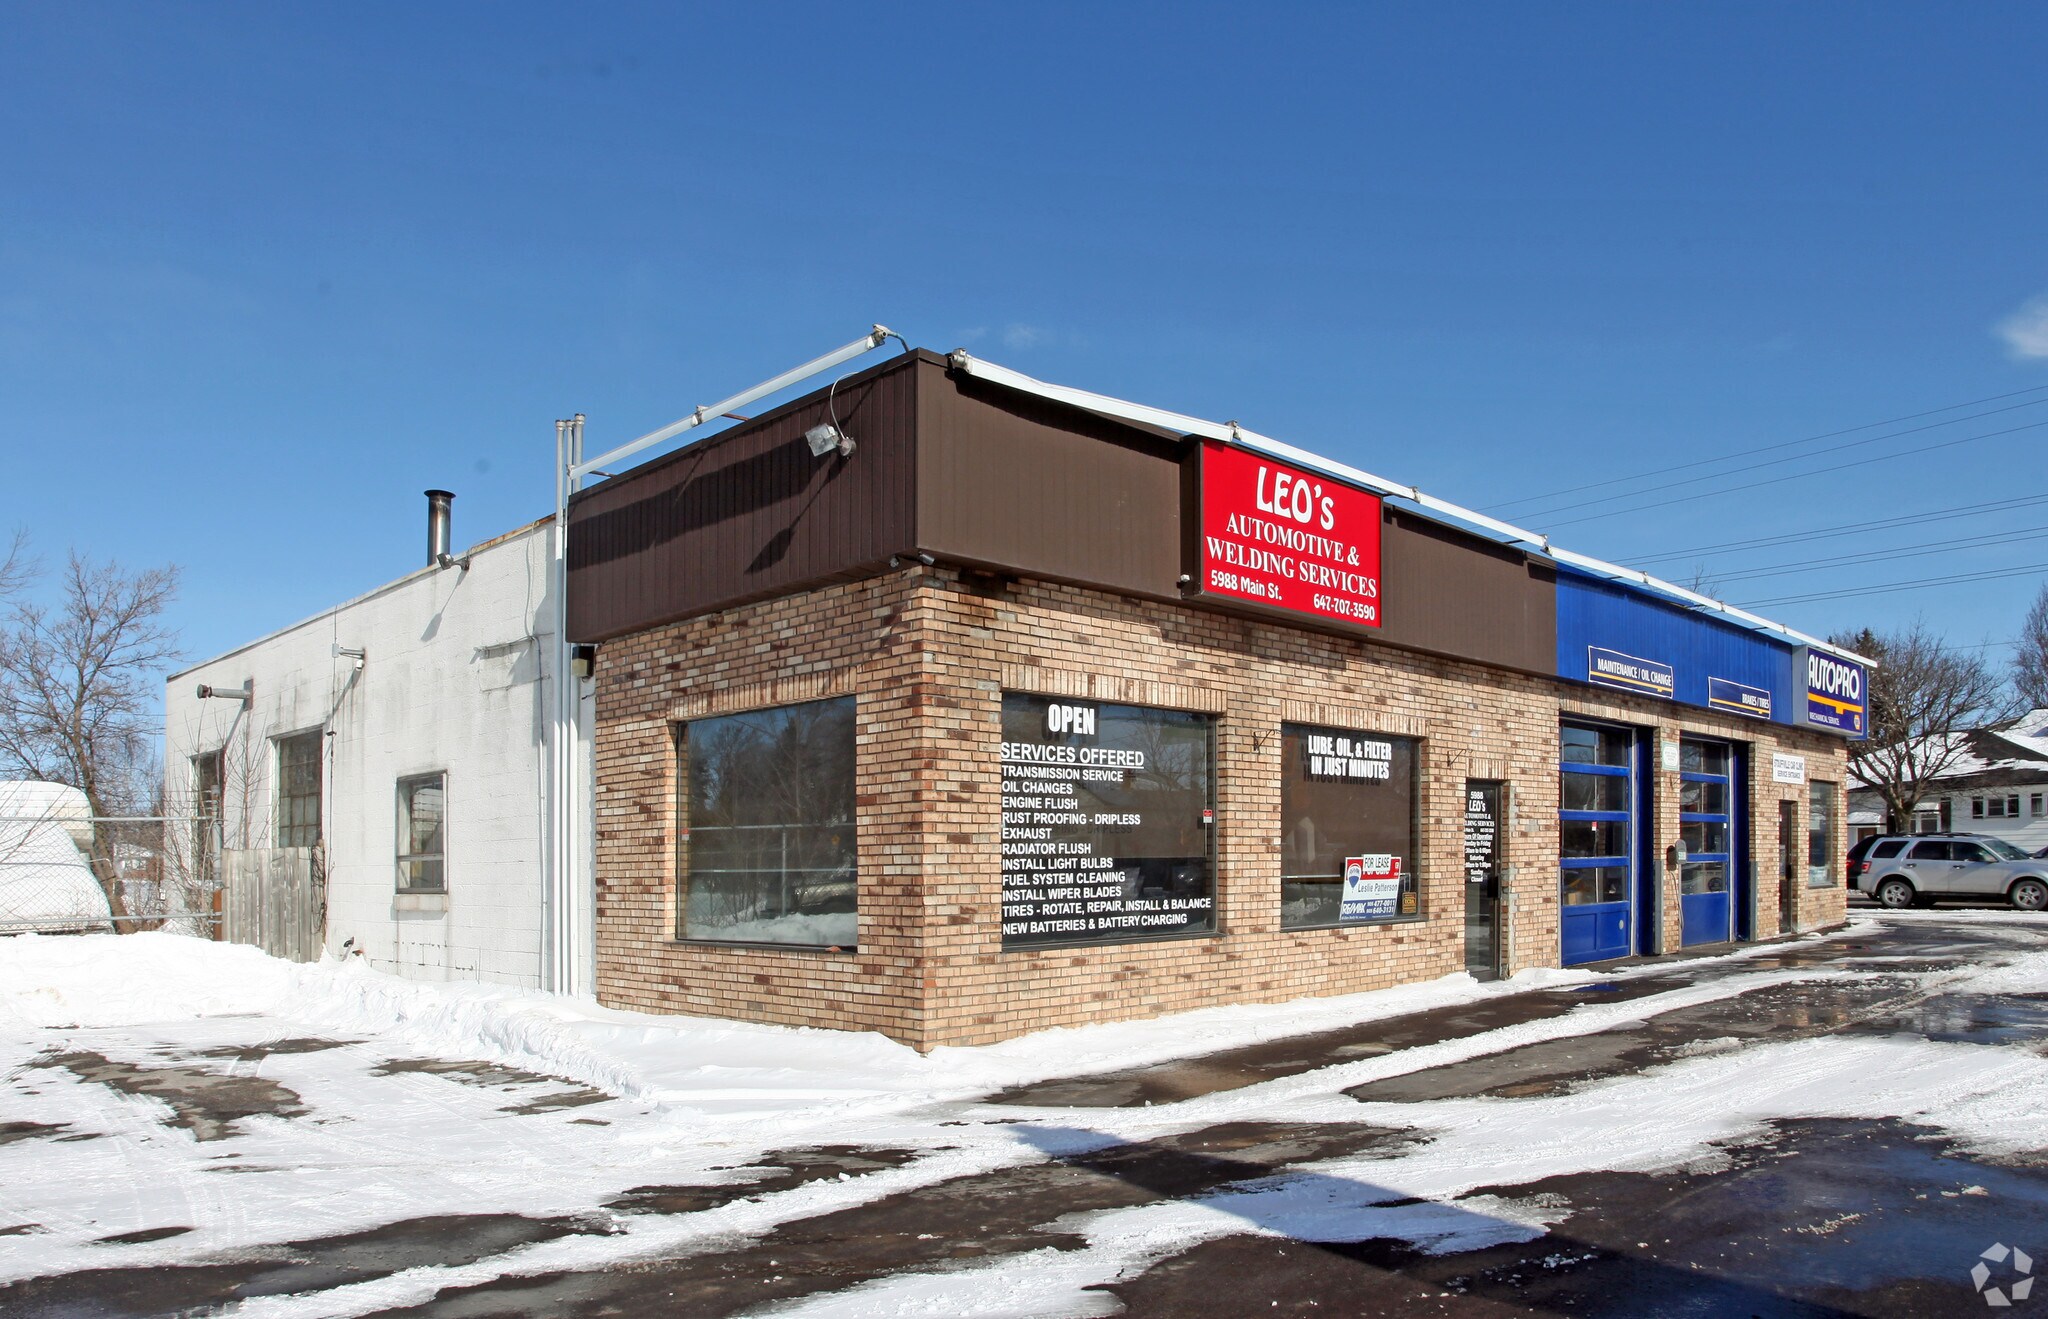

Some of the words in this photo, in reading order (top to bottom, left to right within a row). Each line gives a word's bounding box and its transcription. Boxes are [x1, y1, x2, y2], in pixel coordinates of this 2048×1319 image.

[1256, 466, 1334, 530] LEO's
[1226, 512, 1344, 562] AUTOMOTIVE
[1347, 546, 1360, 566] &
[1206, 535, 1295, 578] WELDING
[1300, 561, 1377, 598] SERVICES
[1211, 569, 1238, 590] 5988
[1240, 576, 1265, 597] Main
[1267, 583, 1283, 600] St.
[1313, 593, 1375, 621] 647-707-3590
[1597, 658, 1638, 679] MAINTENANCE
[1641, 669, 1650, 681] OIL
[1650, 671, 1672, 687] CHANGE
[1808, 654, 1860, 700] AUTOPRO
[1048, 704, 1095, 735] OPEN
[1000, 742, 1076, 763] SERVICES
[1079, 747, 1145, 766] OFFERED
[1308, 735, 1335, 757] LUBE,
[1336, 738, 1354, 758] OIL,
[1355, 743, 1363, 757] &
[1364, 740, 1392, 761] FILTER
[1002, 765, 1080, 780] TRANSMISSION
[1082, 769, 1124, 782] SERVICE
[1311, 756, 1322, 775] IN
[1324, 757, 1349, 777] JUST
[1349, 759, 1390, 779] MINUTES
[1002, 781, 1020, 793] OIL
[1022, 782, 1073, 794] CHANGES
[1002, 797, 1042, 809] ENGINE
[1044, 798, 1078, 810] FLUSH
[1469, 800, 1486, 812] LEO's
[1002, 812, 1031, 824] RUST
[1033, 813, 1087, 825] PROOFING
[1095, 814, 1141, 825] DRIPLESS
[1002, 828, 1052, 839] EXHAUST
[1002, 843, 1056, 855] RADIATOR
[1058, 843, 1092, 855] FLUSH
[1002, 858, 1046, 870] INSTALL
[1048, 858, 1078, 870] LIGHT
[1080, 857, 1113, 869] BULBS
[1365, 857, 1374, 868] FOR
[1375, 857, 1390, 868] LEASE
[1002, 874, 1030, 886] FUEL
[1032, 872, 1074, 885] SYSTEM
[1077, 871, 1126, 883] CLEANING
[1002, 889, 1046, 902] INSTALL
[1048, 888, 1081, 900] WIPER
[1083, 886, 1122, 898] BLADES
[1003, 904, 1034, 917] TIRES
[1042, 903, 1085, 916] ROTATE,
[1087, 901, 1125, 913] REPAIR,
[1125, 900, 1161, 912] INSTALL
[1163, 899, 1169, 910] &
[1171, 897, 1211, 910] BALANCE
[1003, 923, 1028, 936] NEW
[1030, 918, 1086, 933] BATTERIES
[1088, 918, 1096, 930] &
[1098, 915, 1141, 929] BATTERY
[1141, 913, 1188, 926] CHARGING
